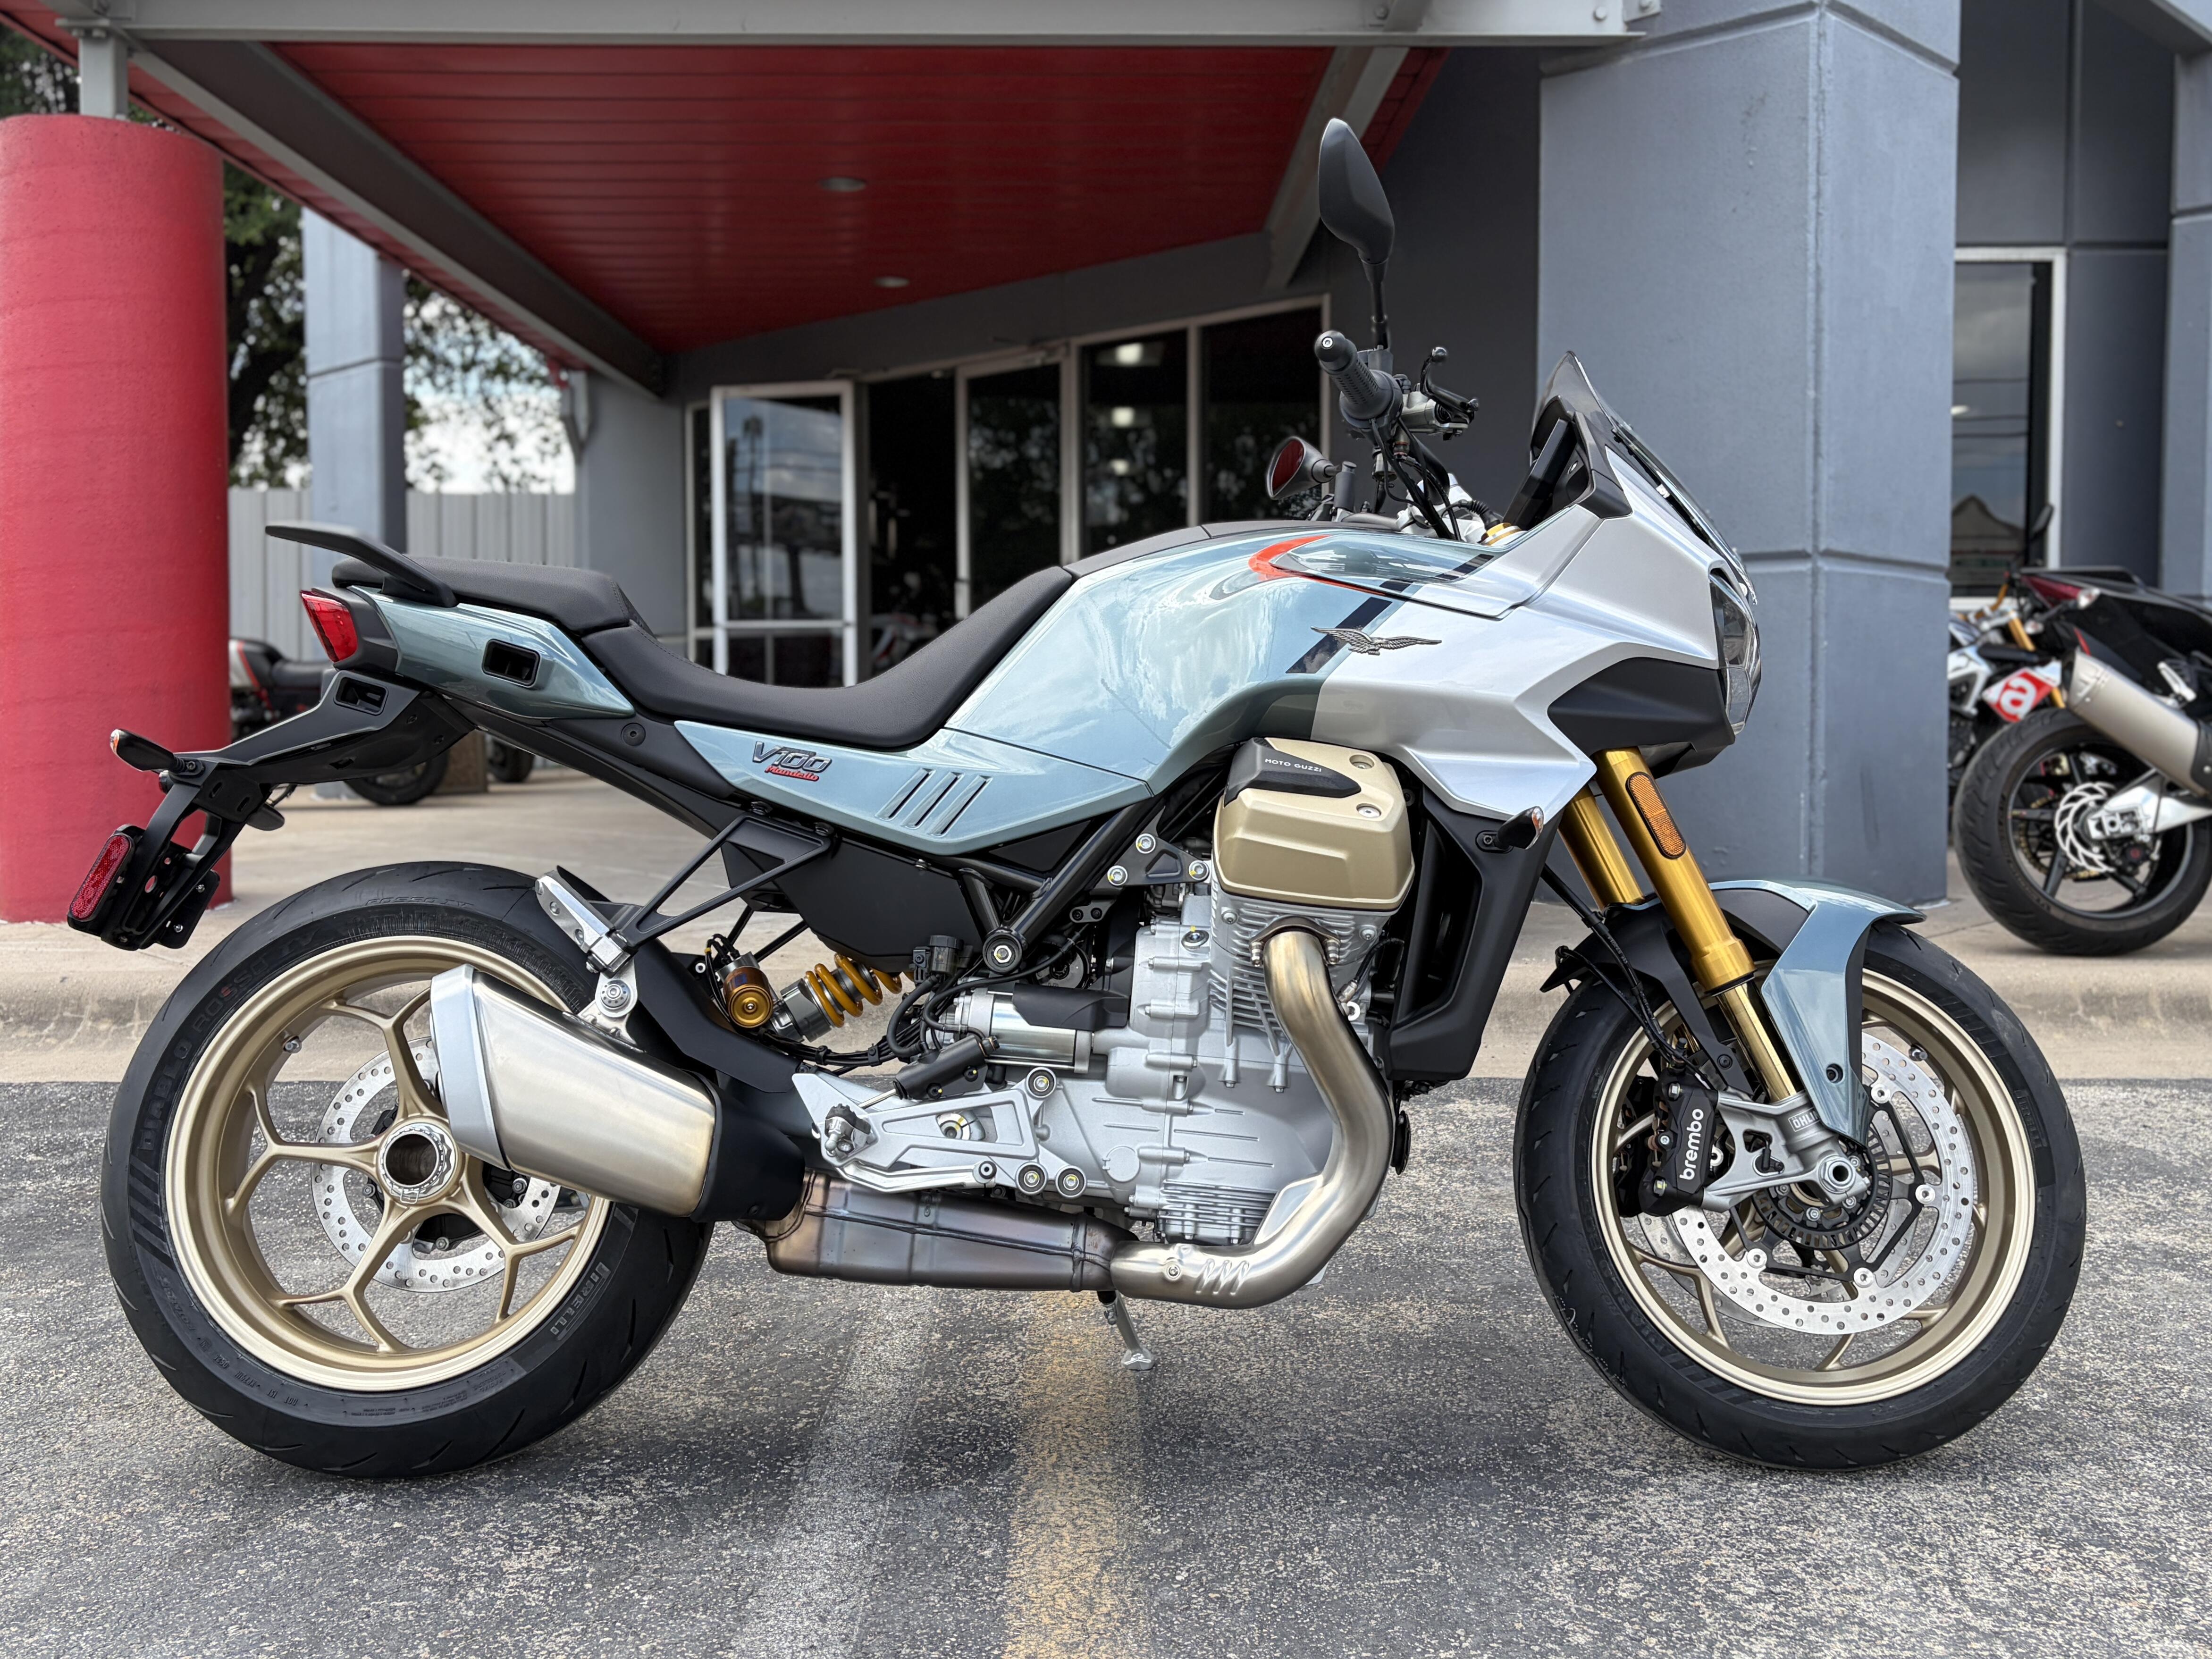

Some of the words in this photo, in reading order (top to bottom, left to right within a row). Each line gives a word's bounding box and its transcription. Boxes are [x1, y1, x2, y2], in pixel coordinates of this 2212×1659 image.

[753, 741, 833, 773] V100
[764, 765, 820, 782] Mandello
[1265, 758, 1291, 767] MOTO
[1294, 763, 1322, 773] GUZZI
[137, 1036, 194, 1151] DIABLO
[192, 955, 270, 1035] ROSSO
[1679, 1108, 1704, 1180] brembo
[550, 1262, 612, 1336] PIRELLI
